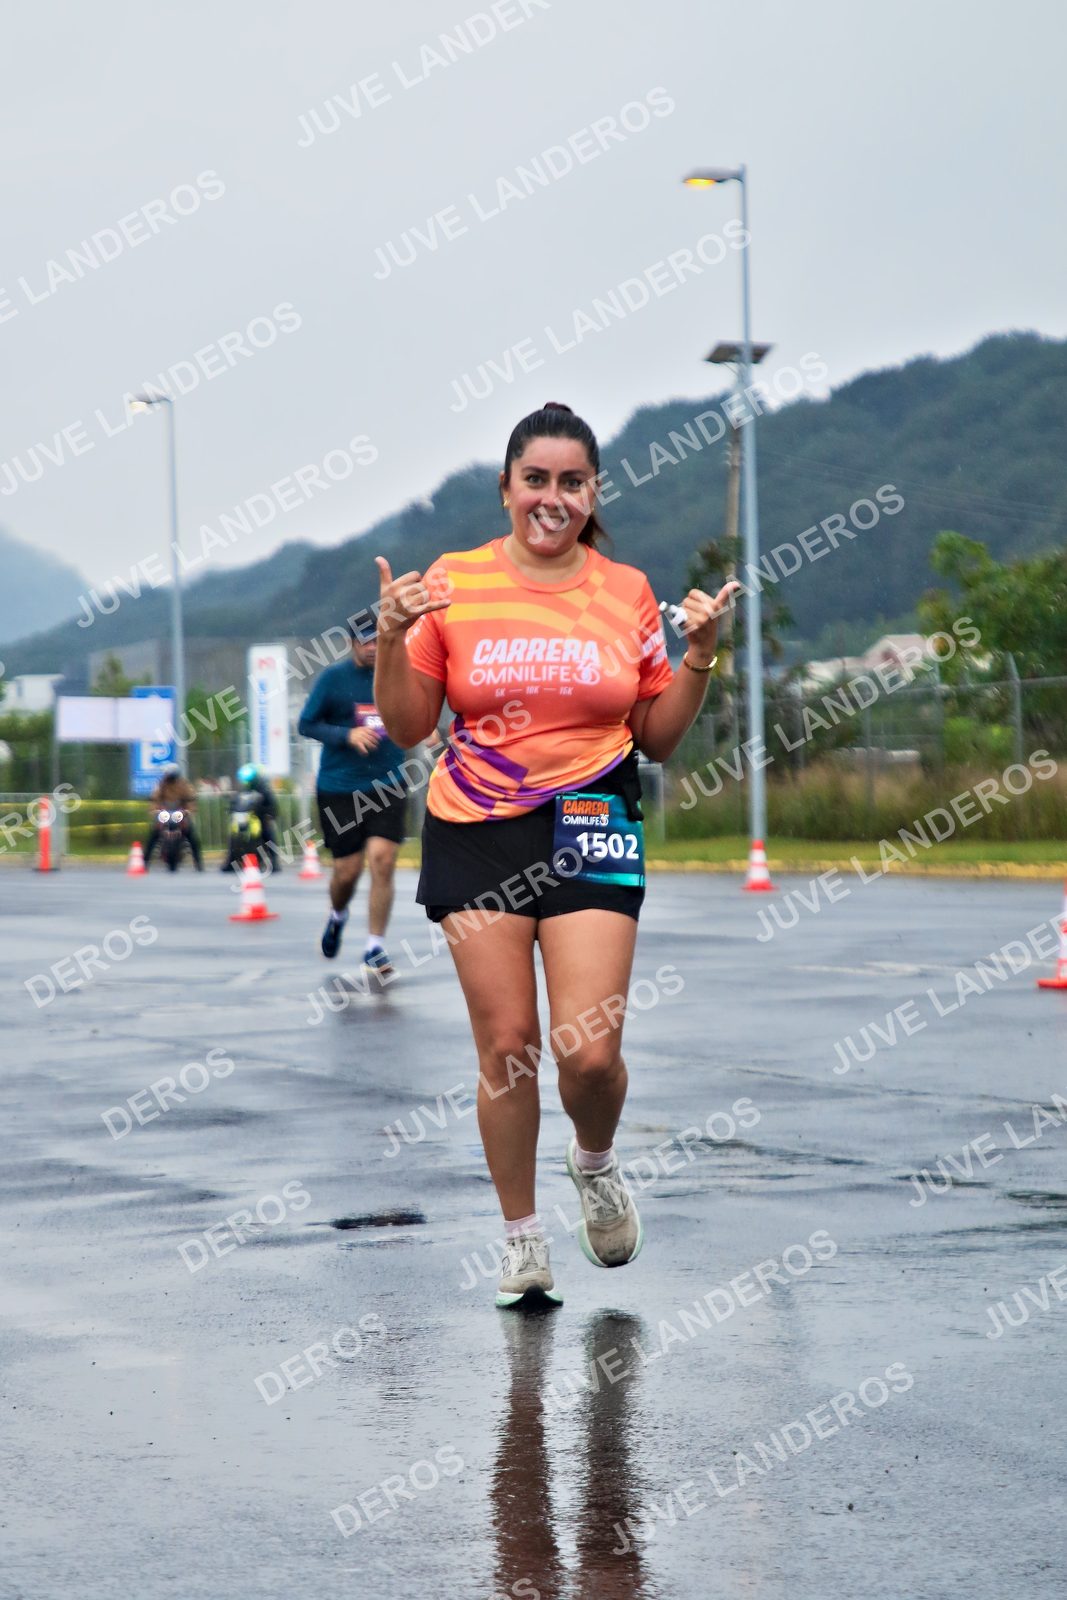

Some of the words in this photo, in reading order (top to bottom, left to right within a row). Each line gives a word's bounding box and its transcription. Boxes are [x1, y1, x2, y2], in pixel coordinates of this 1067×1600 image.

[473, 638, 600, 665] CARRERA
[469, 664, 571, 686] OMNILIFE
[563, 799, 609, 815] CARRERA
[562, 815, 600, 827] OMNILIFE
[576, 832, 639, 859] 1502
